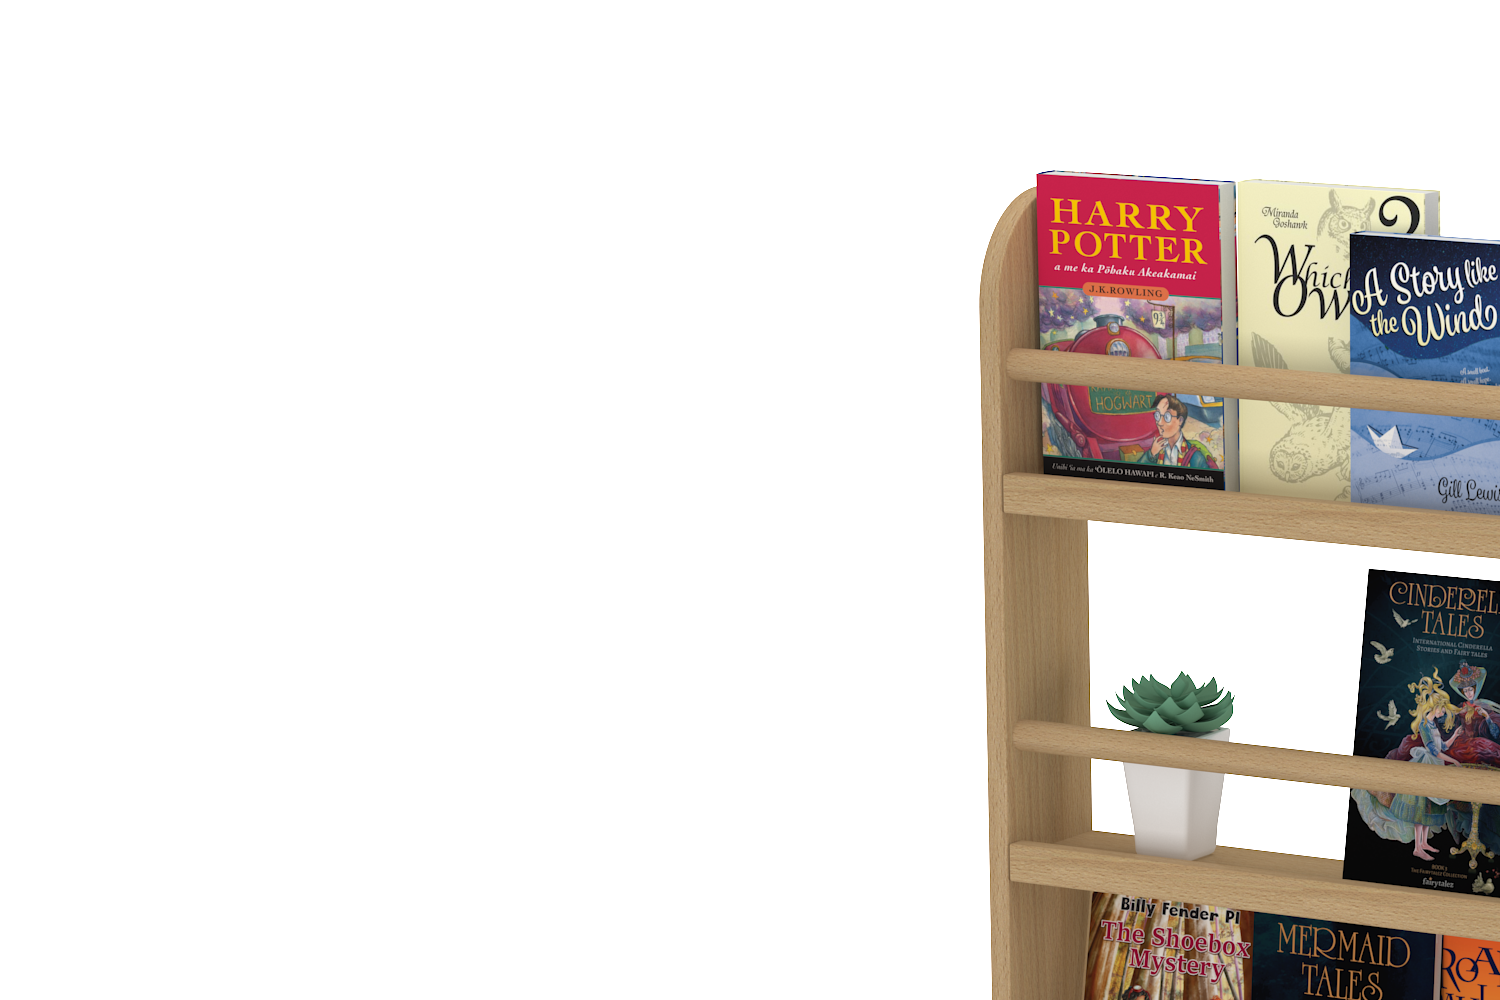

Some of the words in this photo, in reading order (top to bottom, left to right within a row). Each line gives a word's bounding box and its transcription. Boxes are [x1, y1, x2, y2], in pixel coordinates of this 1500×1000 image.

[1050, 198, 1204, 233] HARRY
[1262, 206, 1299, 219] Miranda
[1272, 218, 1308, 230] Goshawk
[1049, 229, 1208, 265] POTTER
[1081, 263, 1094, 273] ka
[1138, 268, 1197, 281] Akeakamai
[1089, 285, 1163, 298] J.K.ROWLING
[1352, 267, 1388, 316] A
[1390, 262, 1465, 305] Story
[1465, 257, 1499, 288] like
[1370, 309, 1400, 338] the
[1401, 294, 1498, 347] Wind
[1096, 395, 1153, 411] HOGWART
[1438, 477, 1463, 504] Gill
[1421, 610, 1485, 639] TALES
[1422, 877, 1455, 889] fairytalez
[1121, 897, 1156, 918] Billy
[1163, 903, 1219, 922] Fender
[1101, 920, 1145, 944] The
[1151, 927, 1251, 958] Shoebox
[1277, 922, 1411, 968] MERMAID
[1129, 948, 1226, 985] Mystery
